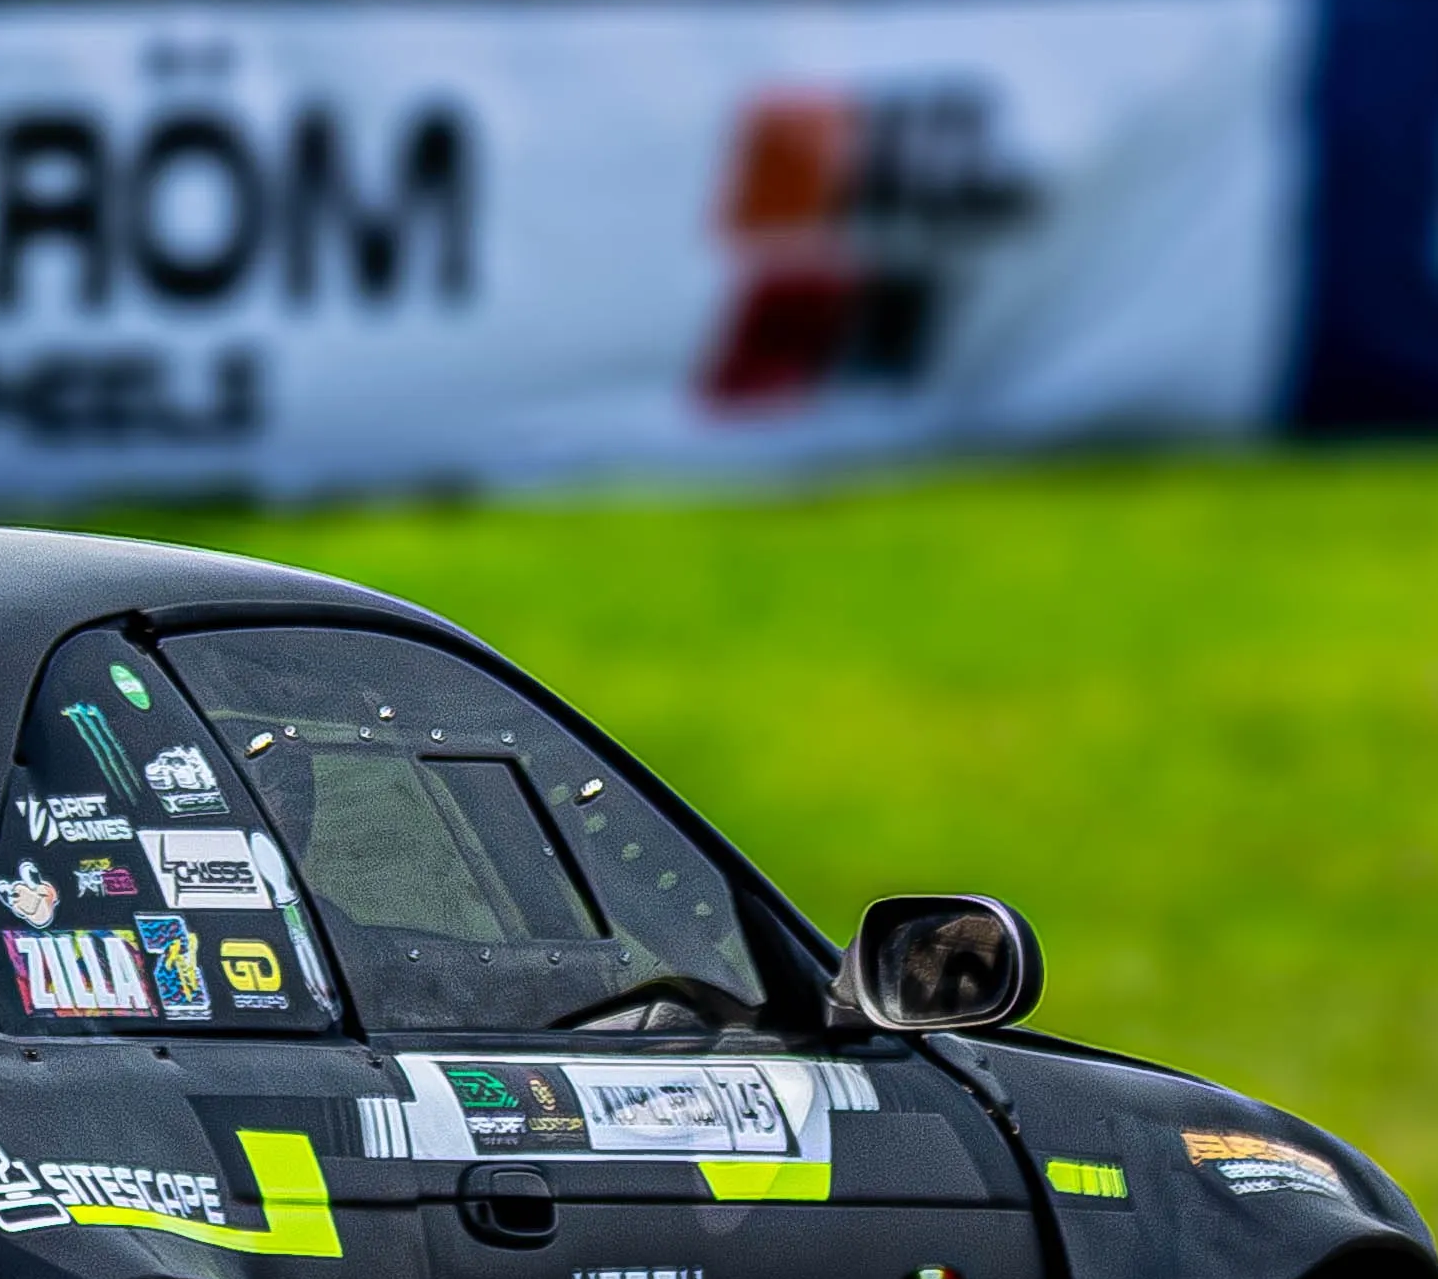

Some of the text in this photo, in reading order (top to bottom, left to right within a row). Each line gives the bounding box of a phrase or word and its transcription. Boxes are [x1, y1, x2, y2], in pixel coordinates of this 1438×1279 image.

[46, 794, 108, 818] DRIFT
[58, 818, 134, 842] GAMES
[17, 936, 150, 1010] ZILLA
[38, 1162, 225, 1224] SITESCAPE
